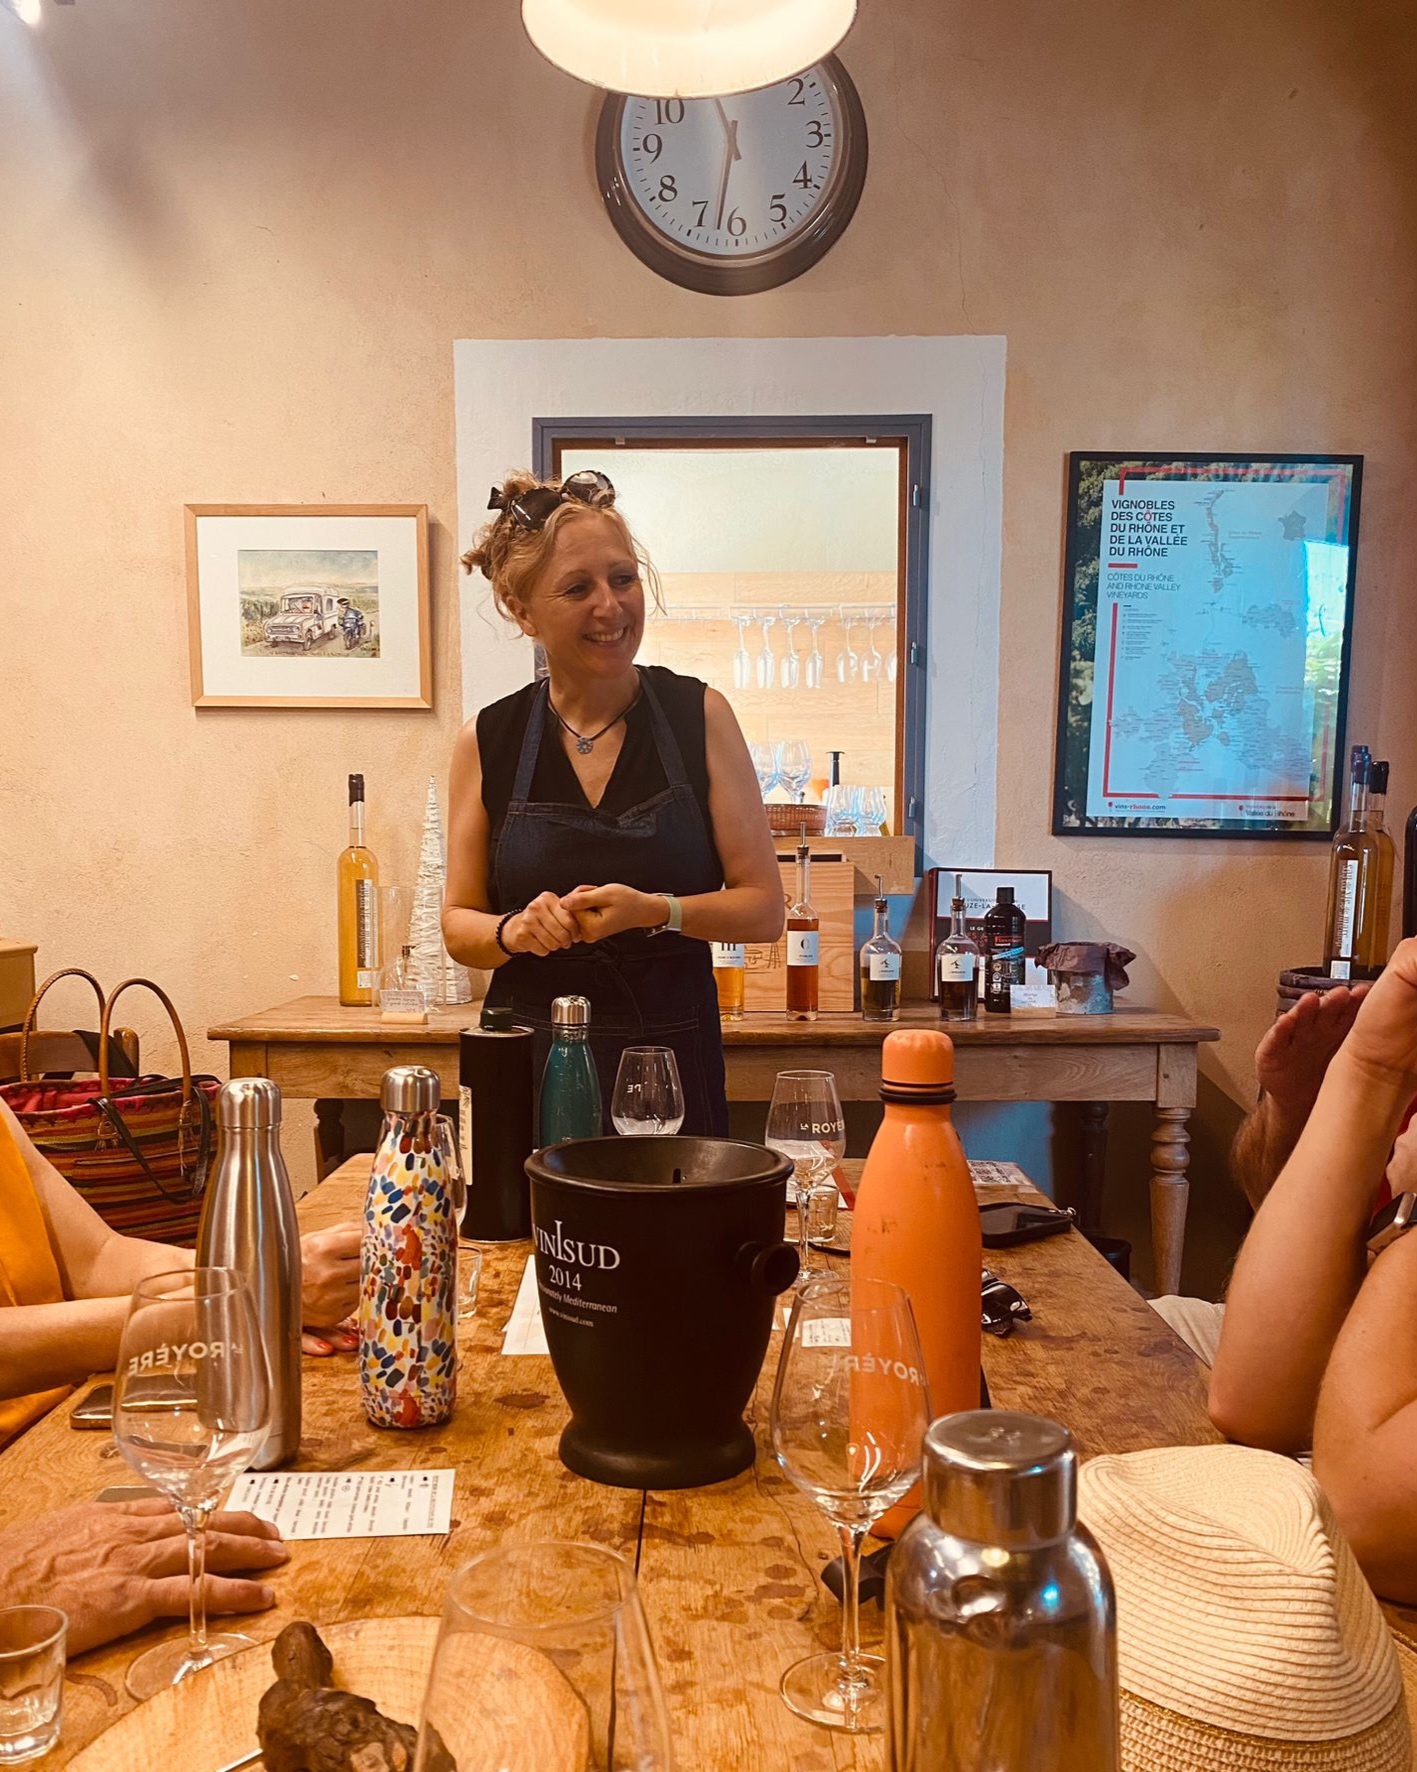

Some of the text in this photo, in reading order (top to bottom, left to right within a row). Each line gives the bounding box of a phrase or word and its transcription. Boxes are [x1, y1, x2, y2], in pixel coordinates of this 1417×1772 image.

[787, 78, 806, 106] 2
[654, 97, 685, 125] 10
[805, 120, 824, 148] 3
[642, 133, 663, 164] 9
[658, 174, 678, 202] 8
[792, 160, 812, 189] 4
[692, 200, 709, 227] 7
[727, 206, 747, 236] 6
[769, 193, 787, 222] 5
[1111, 510, 1172, 522] DES CÔTES
[1112, 500, 1175, 510] VIGNOBLES
[1110, 522, 1185, 534] DU RHÔNE ET
[1110, 534, 1188, 545] DE LA VALLÉE
[1109, 545, 1168, 557] DU RHÔNE
[1107, 572, 1133, 581] CÔTES
[1153, 583, 1181, 591] VALLEY
[1107, 591, 1148, 600] VINEYARDS
[549, 1264, 582, 1291] 2014
[563, 1293, 618, 1313] Mediterranean
